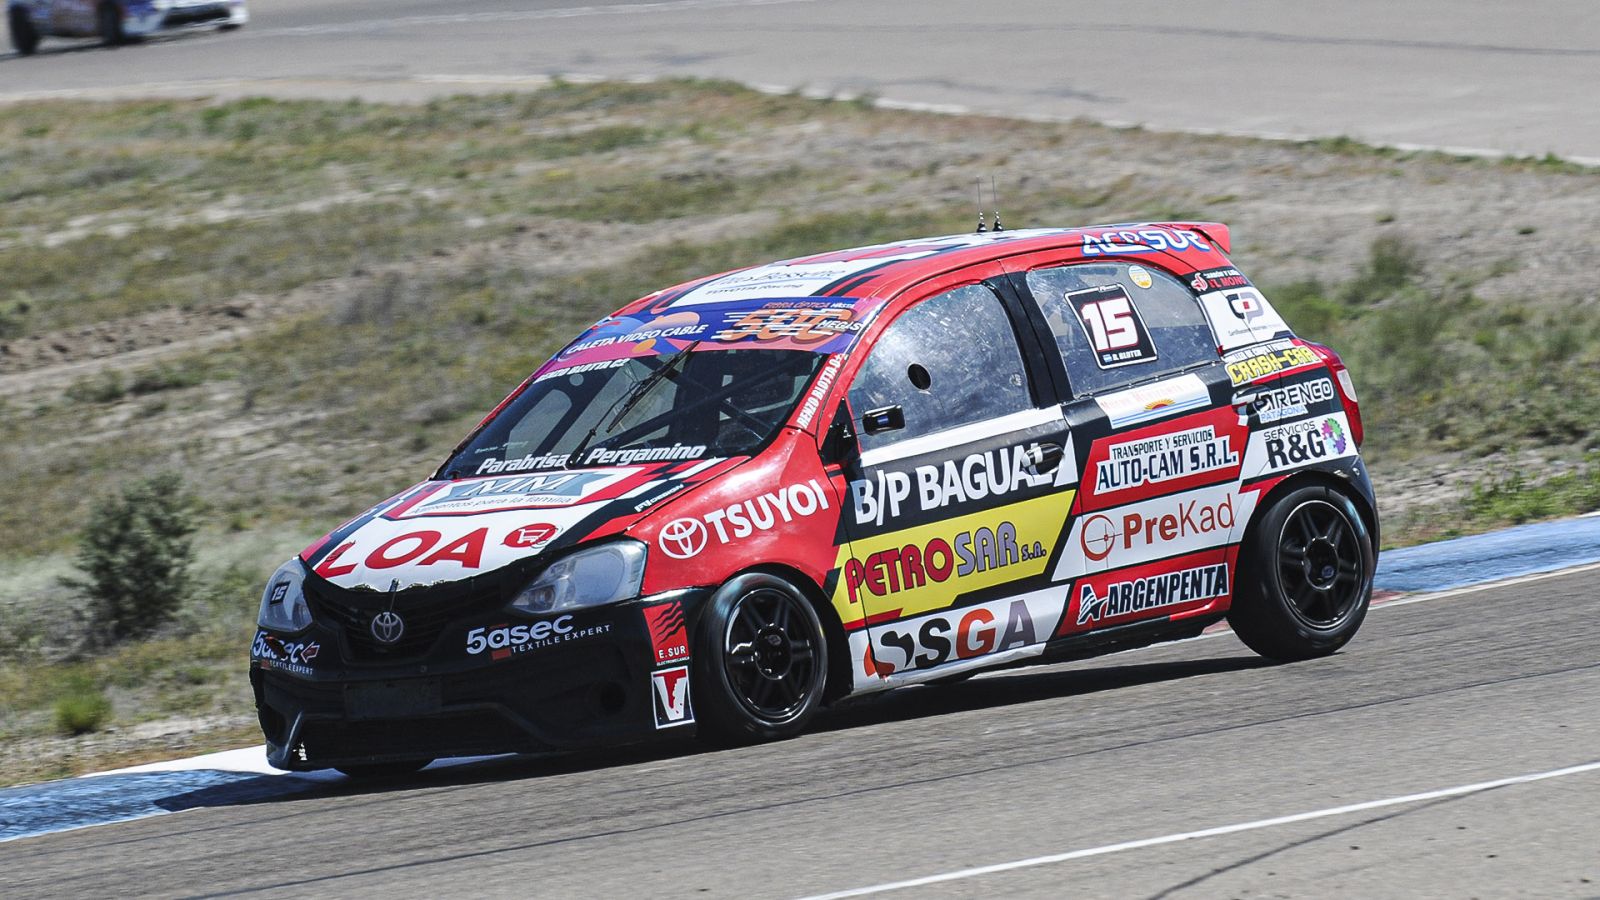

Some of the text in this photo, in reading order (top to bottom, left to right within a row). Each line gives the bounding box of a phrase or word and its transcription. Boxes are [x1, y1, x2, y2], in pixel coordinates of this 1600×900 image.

[565, 324, 709, 355] CALETA VIDEO CABLE
[816, 319, 864, 332] MEGAS
[1081, 297, 1138, 351] 15
[796, 397, 820, 430] RENZO
[811, 366, 838, 401] BLOTTA
[1260, 403, 1307, 422] PATAGONIA
[1112, 428, 1214, 461] TRANSPORTE Y SERVICIOS
[1264, 420, 1316, 441] SERVICIOS
[1265, 428, 1327, 469] R&G
[476, 442, 708, 474] Parabrisa Pergamino
[1097, 439, 1237, 491] AUTO-CAM S.R.L.
[703, 478, 829, 545] TSUYOI
[851, 468, 911, 526] B/P
[1122, 493, 1235, 550] PreKad
[312, 526, 490, 580] LOA
[844, 520, 1047, 604] PETROSAR S.A.
[271, 585, 288, 601] 15
[1105, 563, 1228, 616] ARGENPENTA
[466, 614, 574, 655] 5asec
[512, 624, 611, 654] TEXTILE EXPERT
[658, 645, 686, 660] E.SUR
[292, 663, 314, 676] EXPERT
